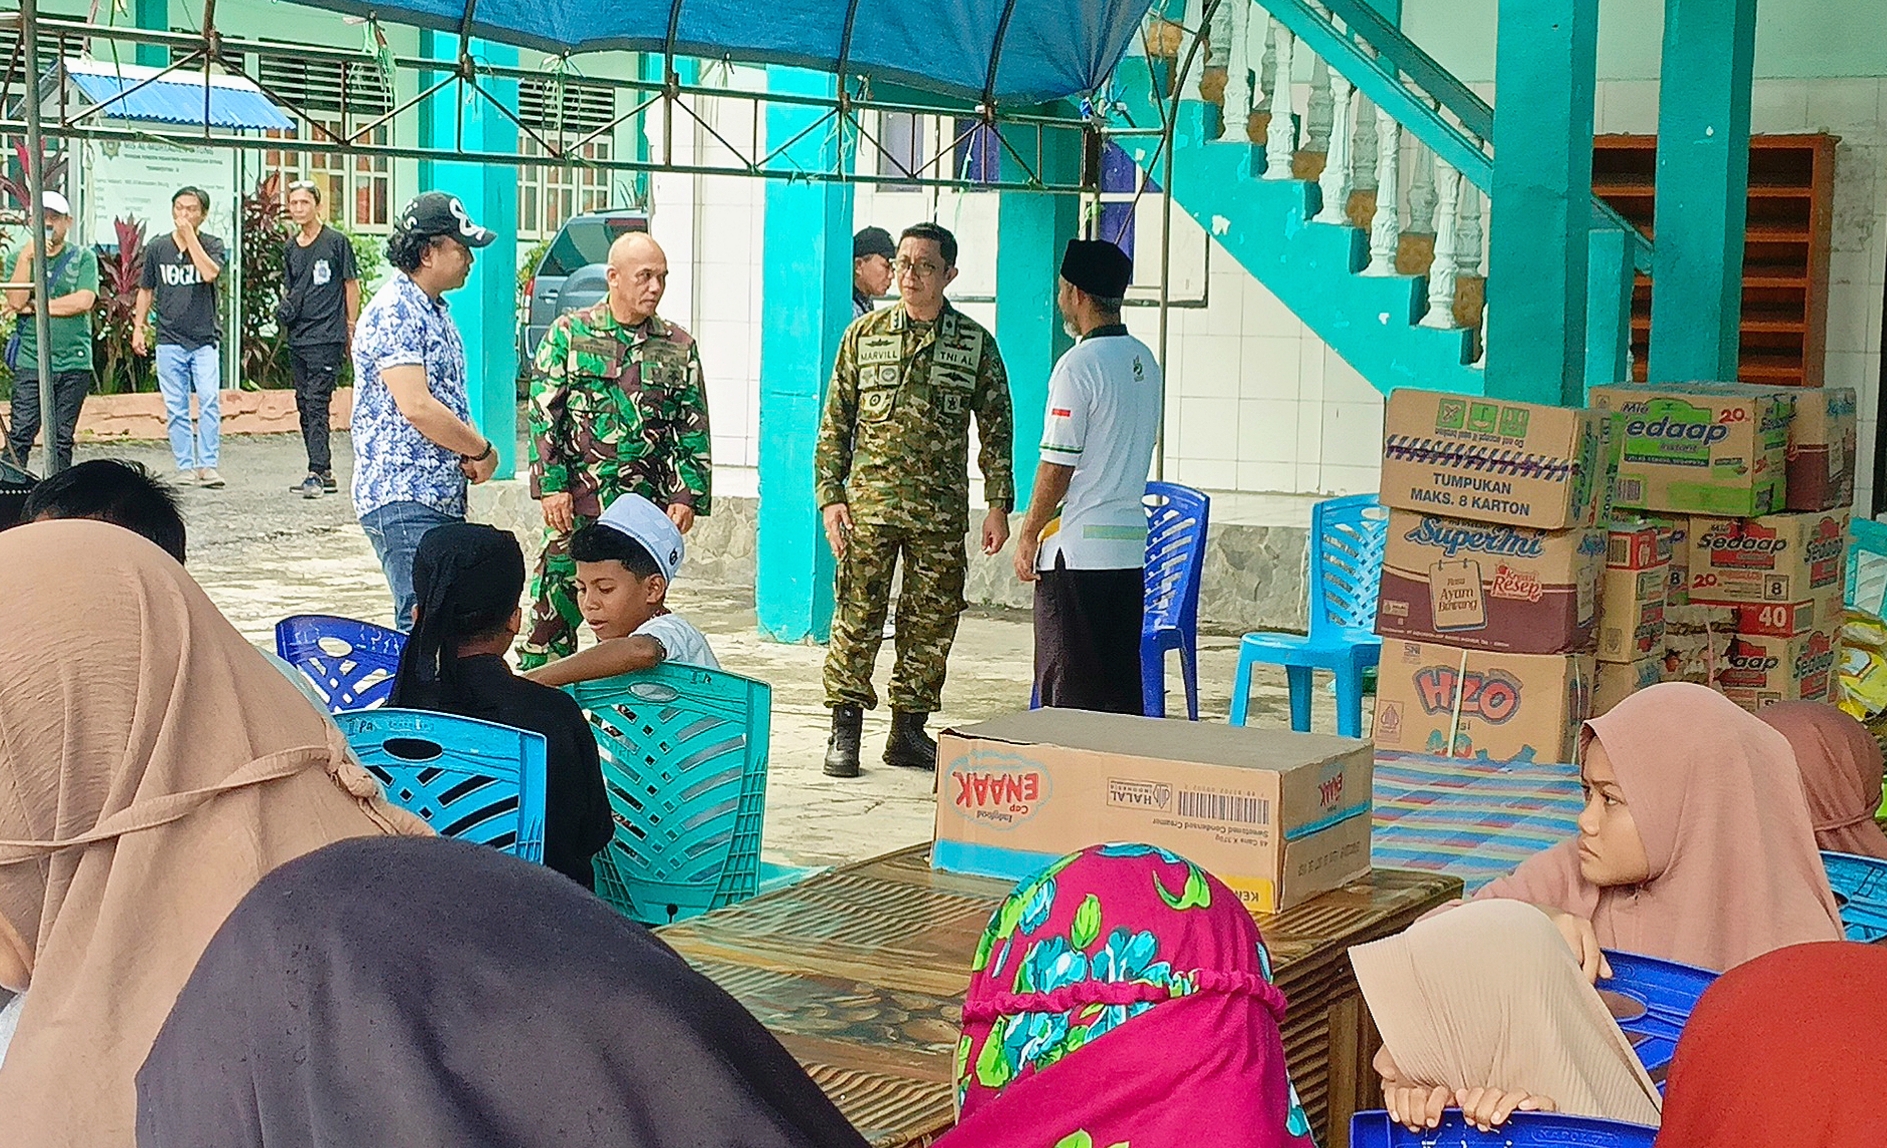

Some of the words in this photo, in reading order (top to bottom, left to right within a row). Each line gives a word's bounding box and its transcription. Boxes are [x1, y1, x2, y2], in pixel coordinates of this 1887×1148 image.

[861, 351, 898, 360] MARVILL
[940, 351, 958, 363] TNI
[962, 356, 973, 366] AL
[1622, 402, 1649, 414] Mie
[1719, 408, 1746, 423] 20
[1625, 416, 1729, 446] edaap
[1433, 473, 1511, 495] TUMPUKAN
[1410, 488, 1454, 505] MAKS.
[1459, 495, 1468, 506] 8
[1471, 498, 1530, 516] KARTON
[1697, 532, 1787, 555] Sedaap
[1493, 576, 1540, 597] Resep
[1692, 573, 1717, 589] 20
[1440, 588, 1474, 601] Ayam
[1771, 582, 1782, 596] 8
[1438, 600, 1478, 612] Bawang
[1758, 606, 1787, 628] 40
[952, 771, 1039, 808] ENAAK
[1112, 790, 1152, 805] HALAL
[1010, 804, 1029, 814] Cap
[1152, 818, 1183, 829] Creamer
[1185, 821, 1227, 834] Condensed
[1227, 825, 1269, 837] Sweetened
